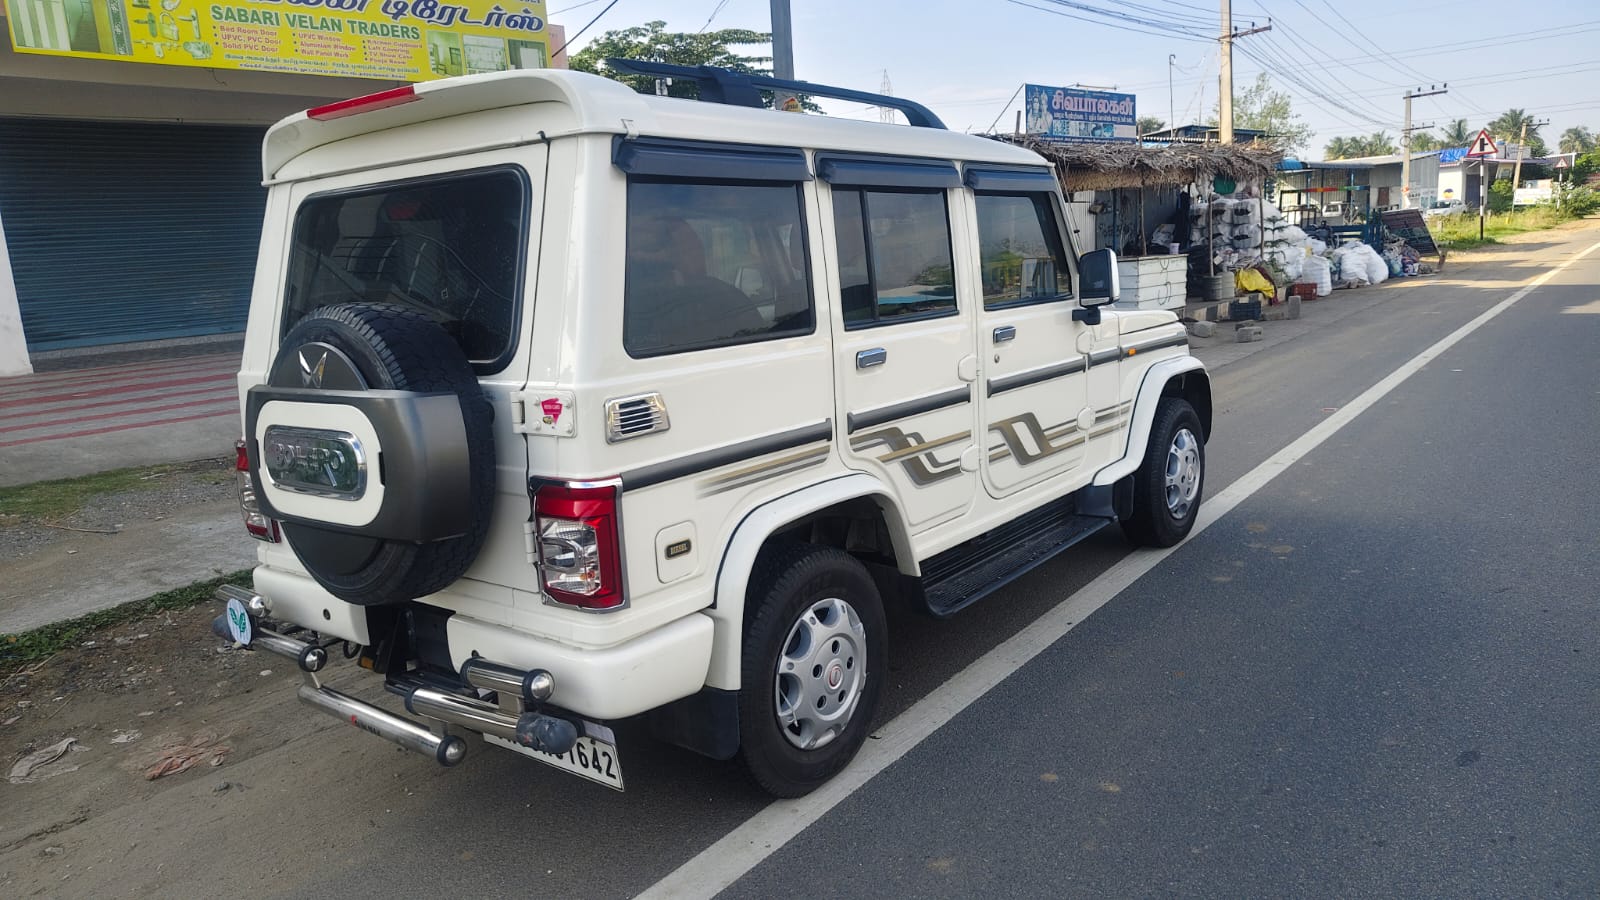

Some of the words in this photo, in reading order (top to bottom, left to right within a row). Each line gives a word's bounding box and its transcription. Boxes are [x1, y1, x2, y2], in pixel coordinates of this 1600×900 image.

[211, 5, 280, 26] SABARI
[285, 13, 343, 32] VELAN
[347, 20, 420, 40] TRADERS
[220, 25, 235, 33] Bed
[237, 27, 258, 35] Room
[298, 32, 316, 40] UPVC
[1052, 90, 1135, 116] சிவபாலகன்
